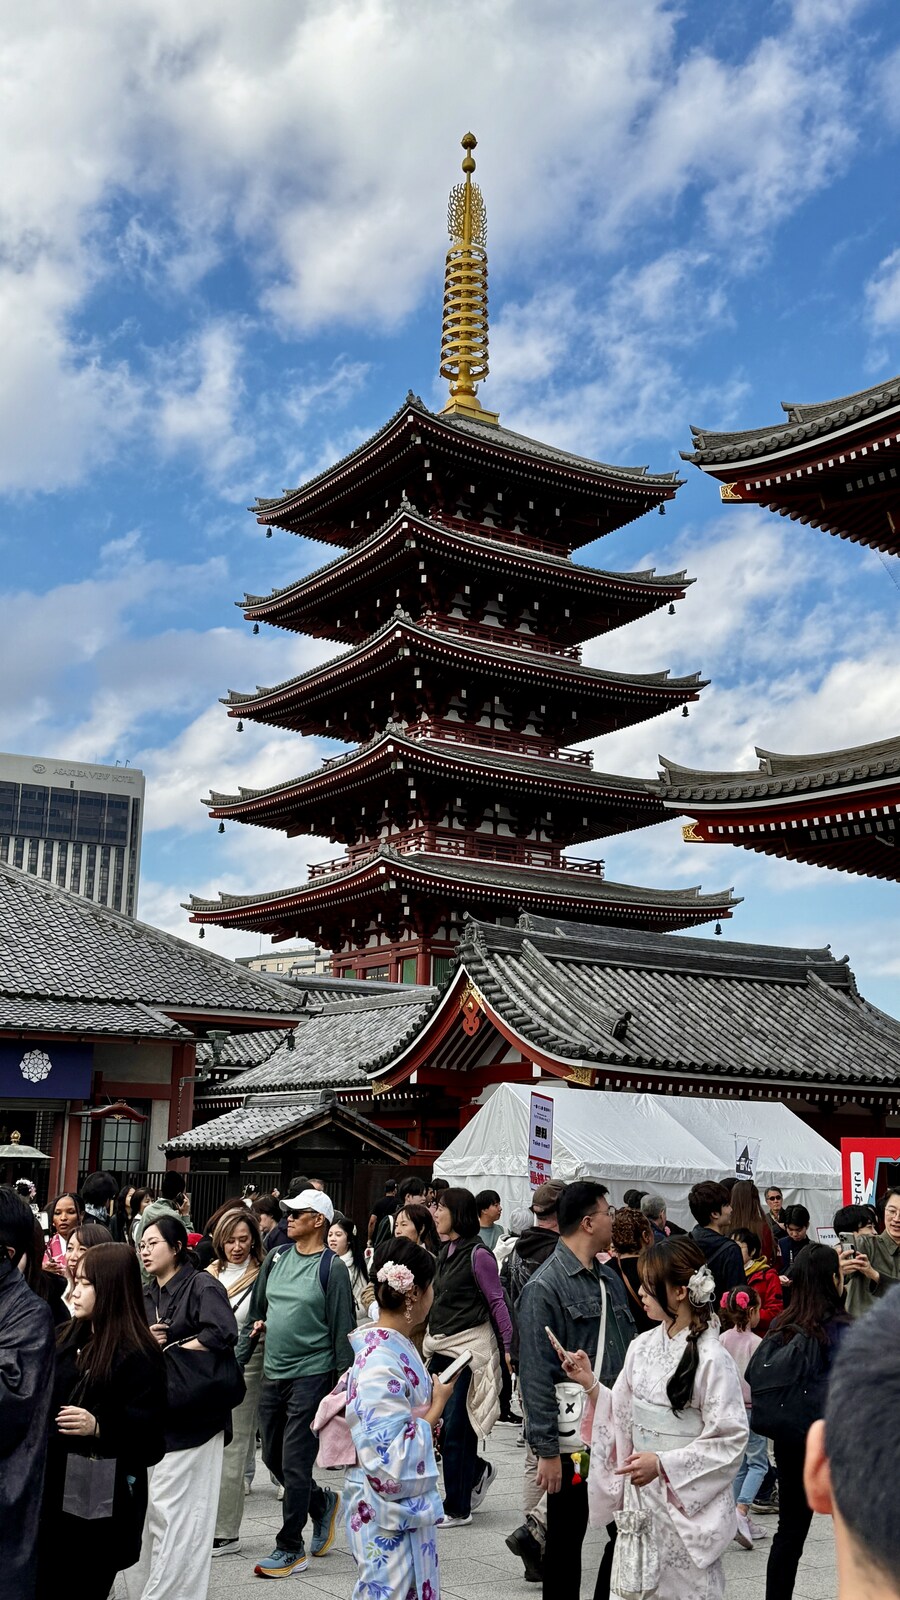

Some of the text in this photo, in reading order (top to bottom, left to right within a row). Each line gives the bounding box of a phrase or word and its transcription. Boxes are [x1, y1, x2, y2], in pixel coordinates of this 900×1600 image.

[53, 768, 135, 784] ASAKUSA VIEW HOTEL
